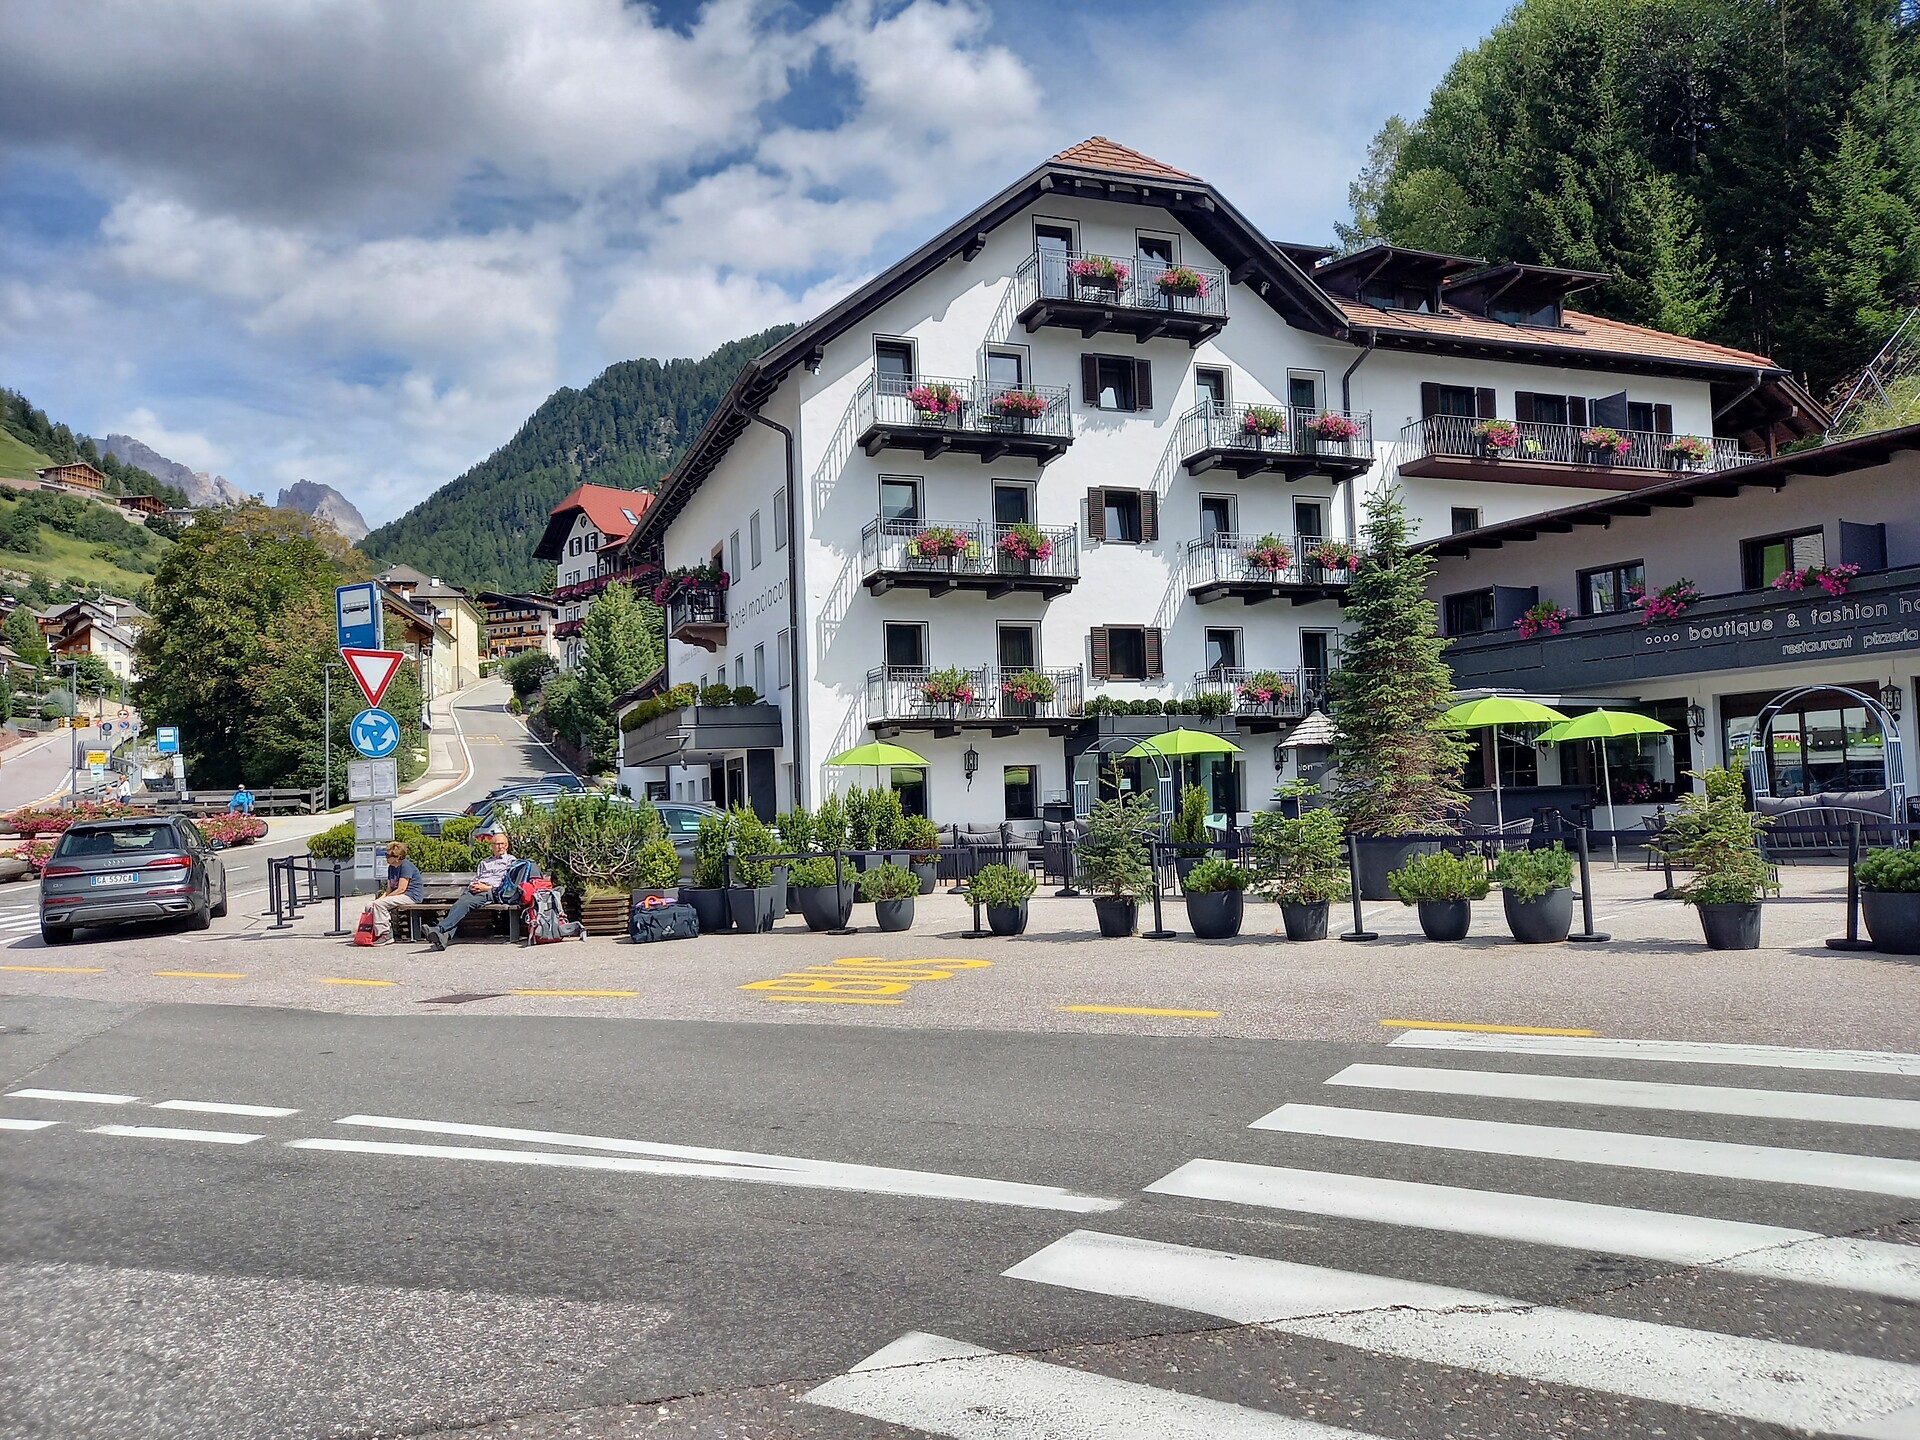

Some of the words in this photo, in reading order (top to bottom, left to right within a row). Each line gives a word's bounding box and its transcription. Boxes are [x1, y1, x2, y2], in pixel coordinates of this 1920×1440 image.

[730, 600, 747, 631] hotel
[1688, 618, 1774, 641] boutique
[1786, 613, 1800, 628] &
[1810, 603, 1888, 625] fashion
[1782, 634, 1853, 655] restaurant
[1863, 627, 1919, 648] pizzeria
[736, 956, 993, 995] BUS
